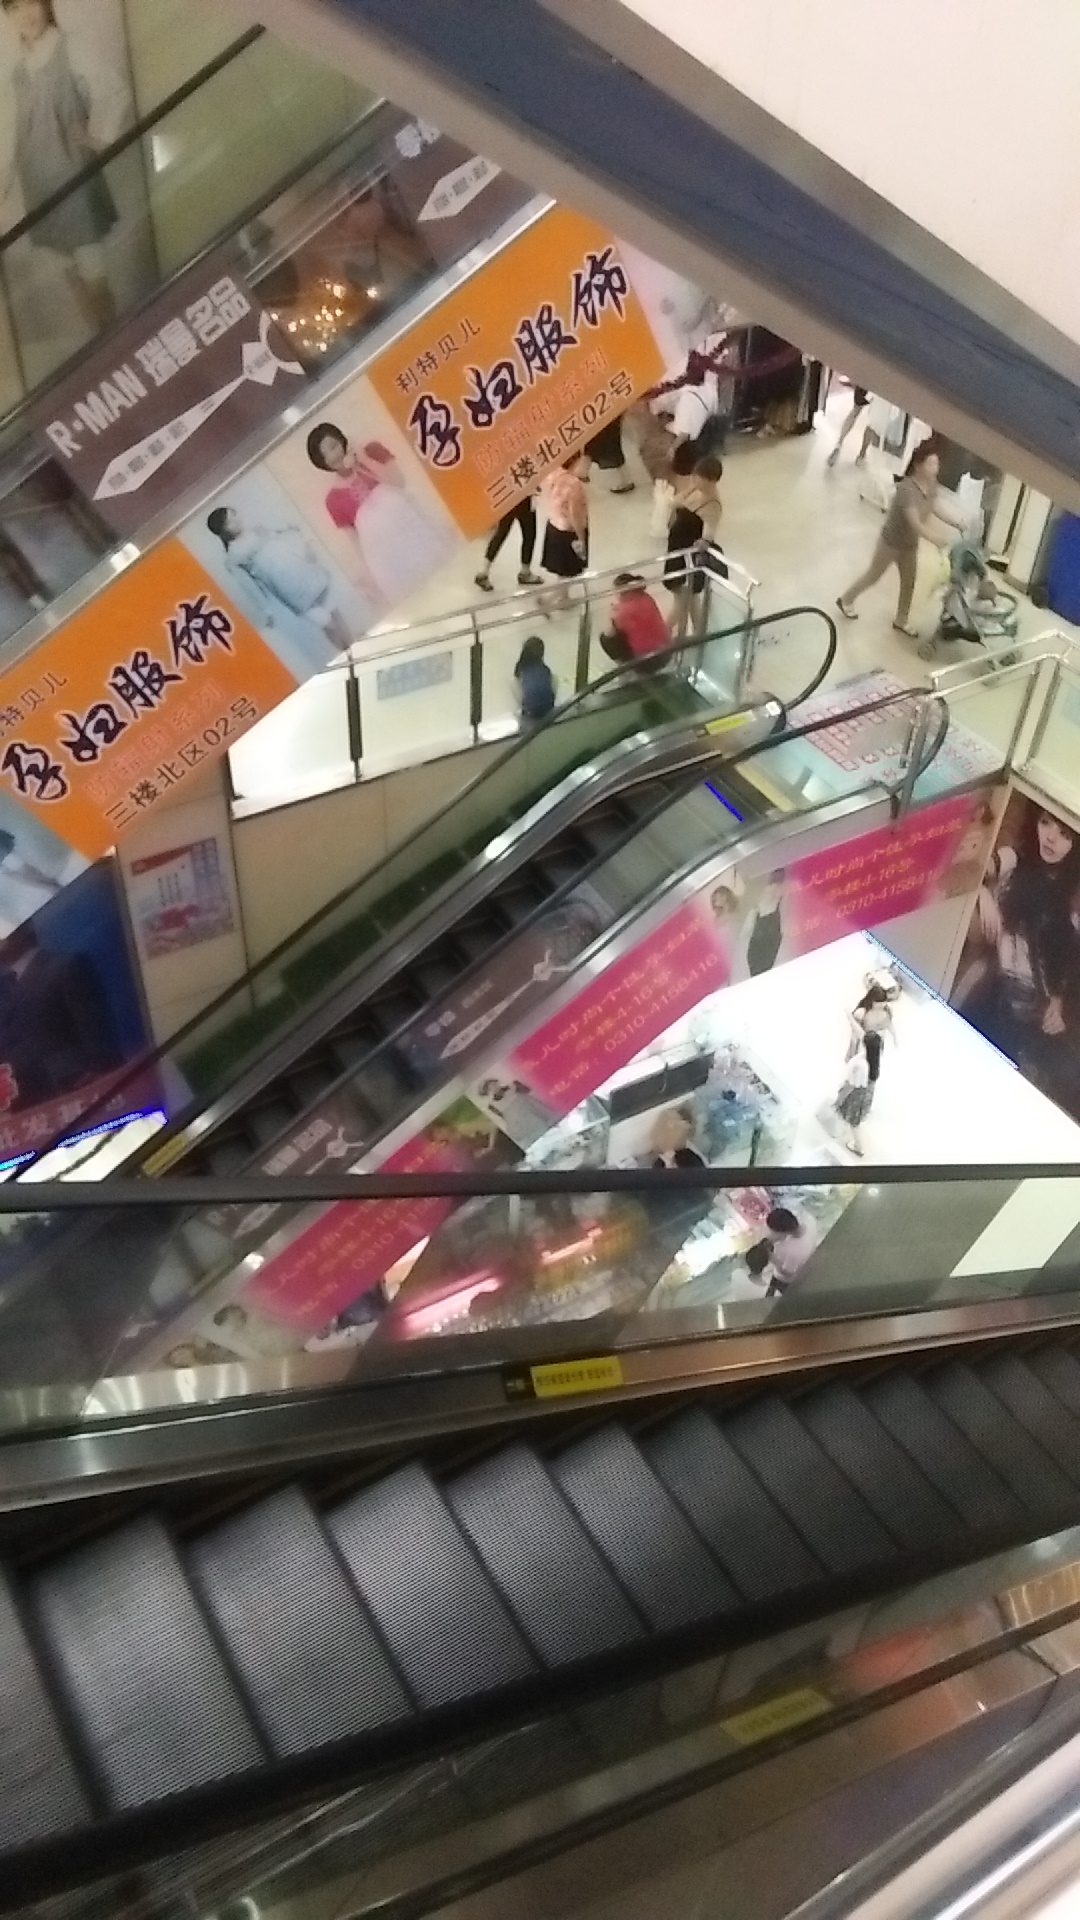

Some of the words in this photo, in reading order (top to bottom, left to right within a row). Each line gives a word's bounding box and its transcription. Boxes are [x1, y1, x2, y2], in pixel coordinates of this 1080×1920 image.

[395, 317, 481, 394] 利特贝儿
[408, 244, 629, 468] 孕妇服饰
[486, 370, 634, 509] 三楼北区02号
[0, 672, 67, 736] 特贝儿
[1, 594, 235, 802] 孕妇服饰
[106, 697, 259, 829] 三楼北区02号
